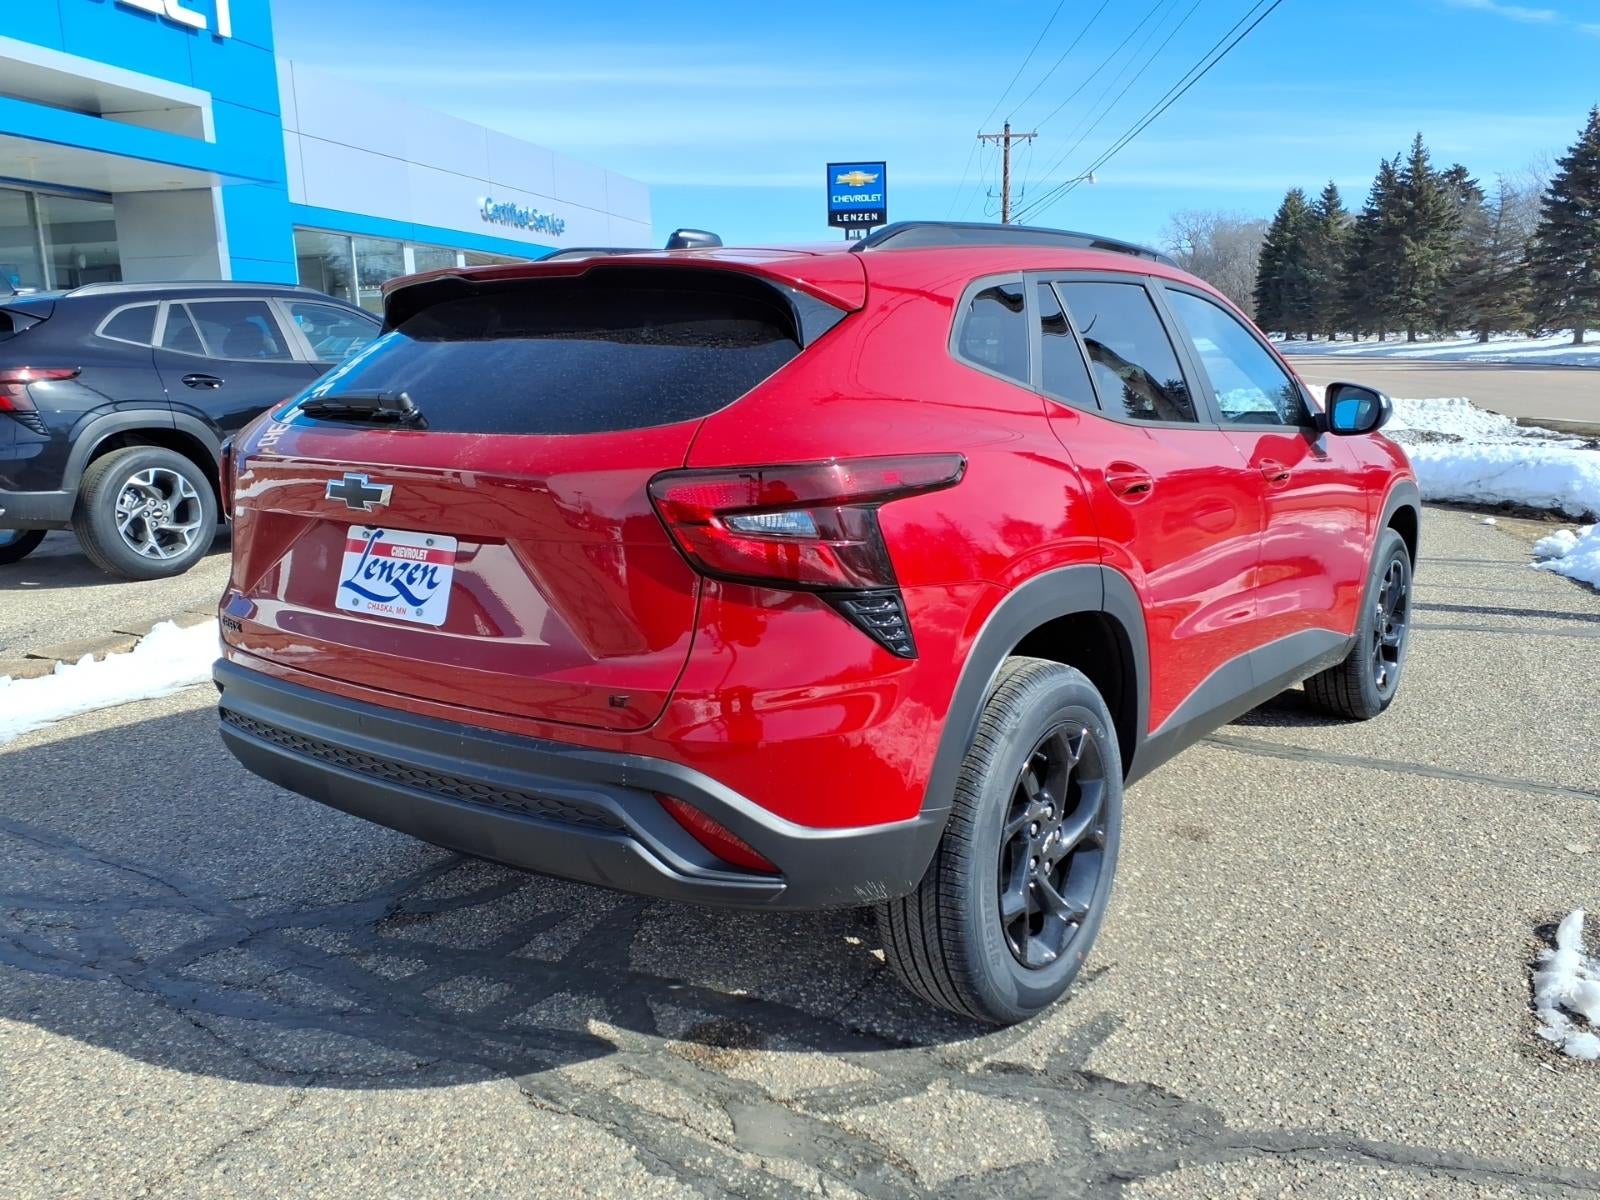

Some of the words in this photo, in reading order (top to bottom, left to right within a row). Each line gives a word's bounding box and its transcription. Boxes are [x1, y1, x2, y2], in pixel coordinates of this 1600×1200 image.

[832, 193, 882, 203] CHEVROLET
[480, 197, 529, 229] Certified
[528, 208, 565, 237] Service
[836, 212, 878, 222] LENZEN
[390, 545, 429, 561] CHEVROLET
[340, 529, 441, 607] Lenzen
[367, 602, 395, 614] CHASKA,
[395, 606, 407, 615] MN
